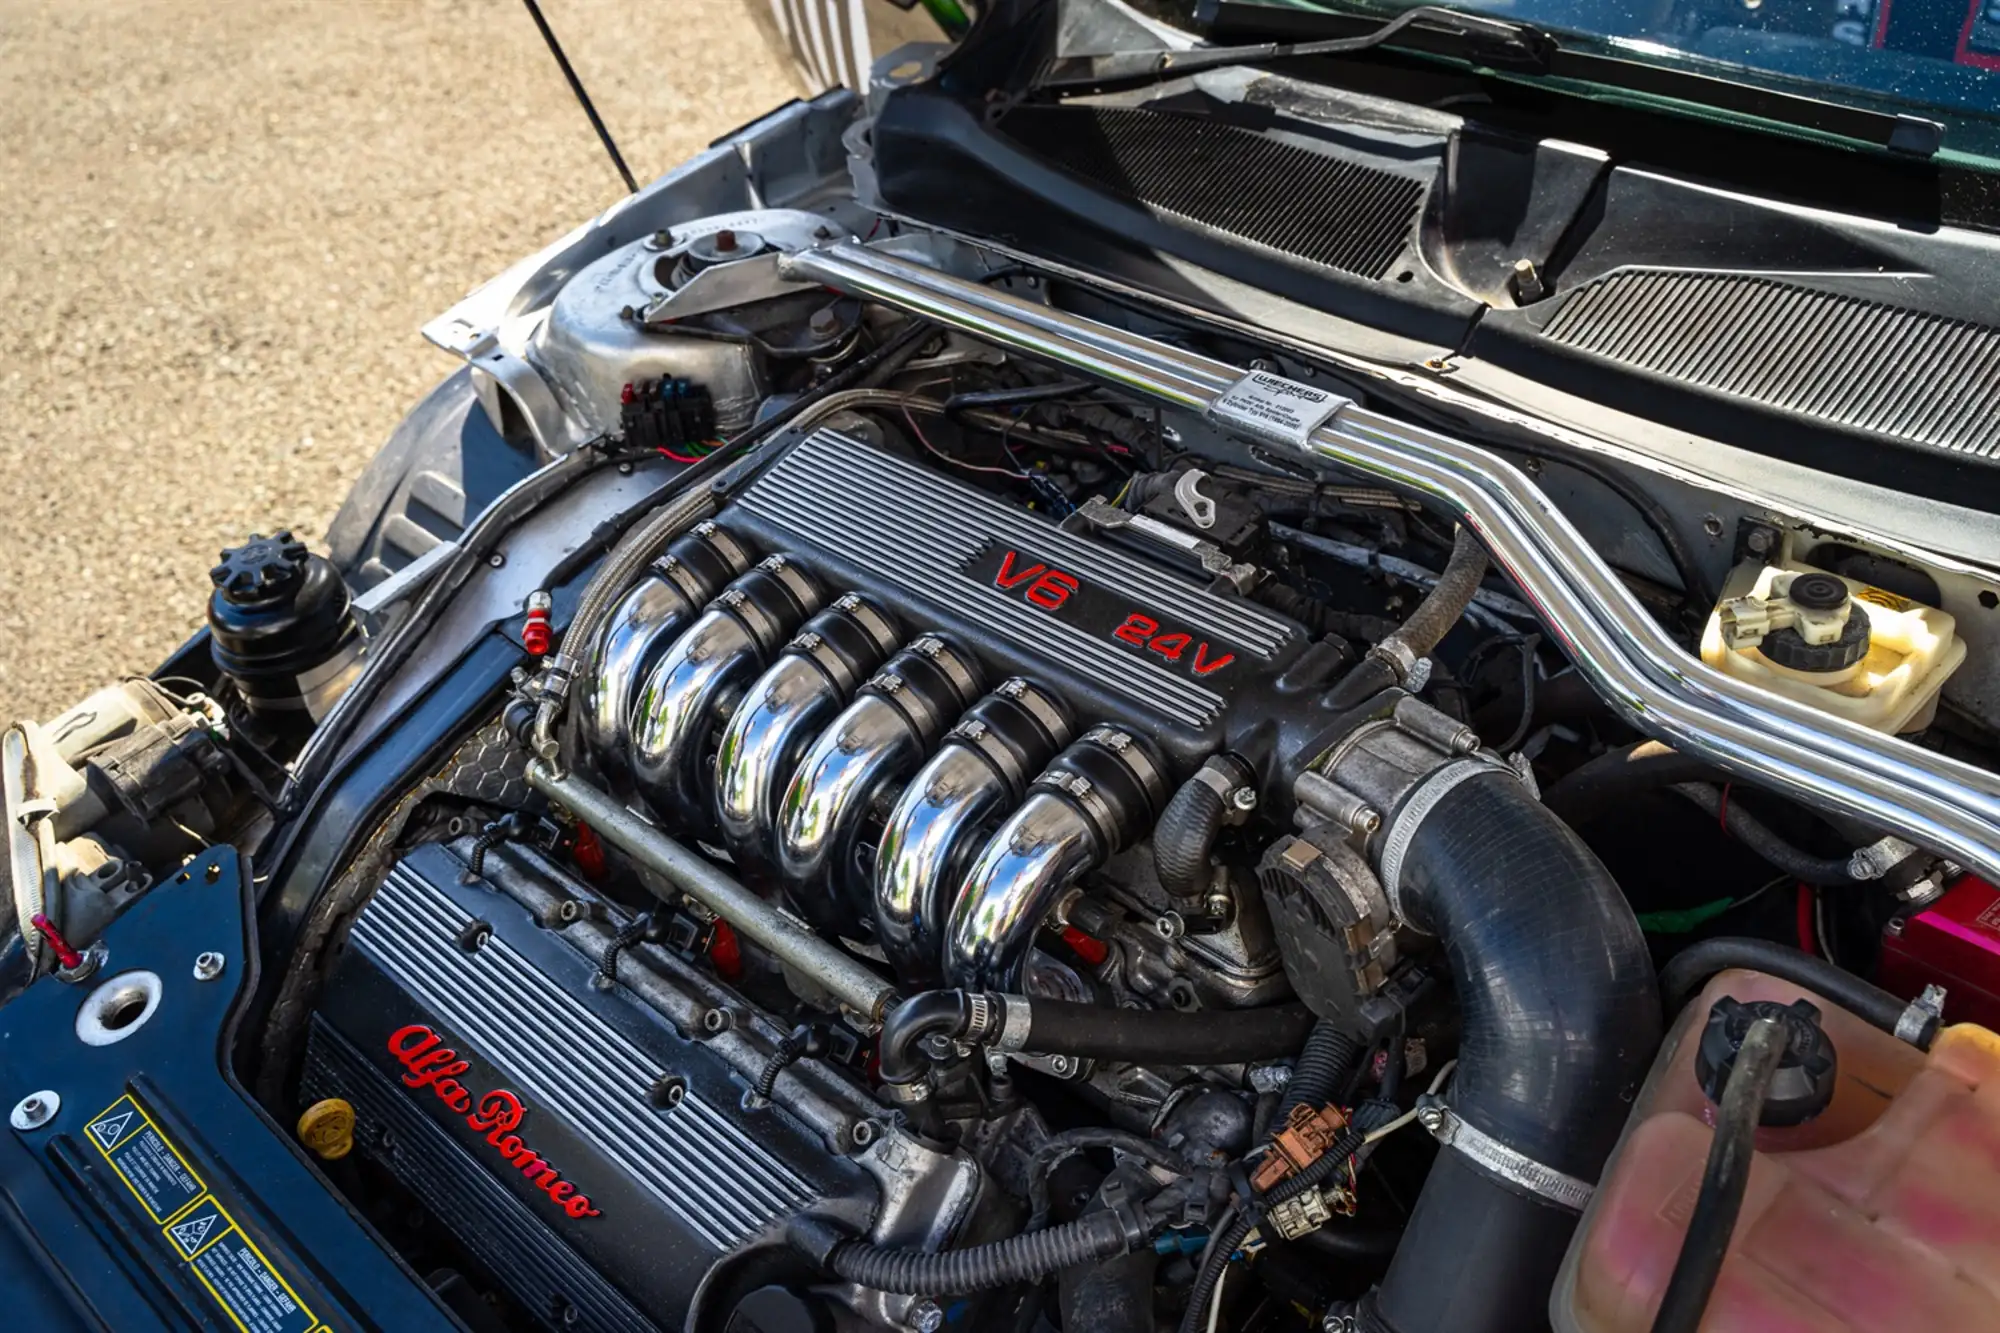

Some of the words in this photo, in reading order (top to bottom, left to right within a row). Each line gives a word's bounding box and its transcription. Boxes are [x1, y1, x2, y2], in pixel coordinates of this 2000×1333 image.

[996, 551, 1079, 610] V6
[1114, 612, 1234, 675] 24V
[387, 1024, 471, 1113] Alfa
[466, 1089, 600, 1219] Romeo
[162, 1153, 181, 1172] DANGER
[179, 1173, 197, 1192] GEFAHR
[239, 1247, 261, 1270] PERICOLO
[259, 1271, 279, 1291] DANGER
[277, 1293, 296, 1313] GEFAHR
